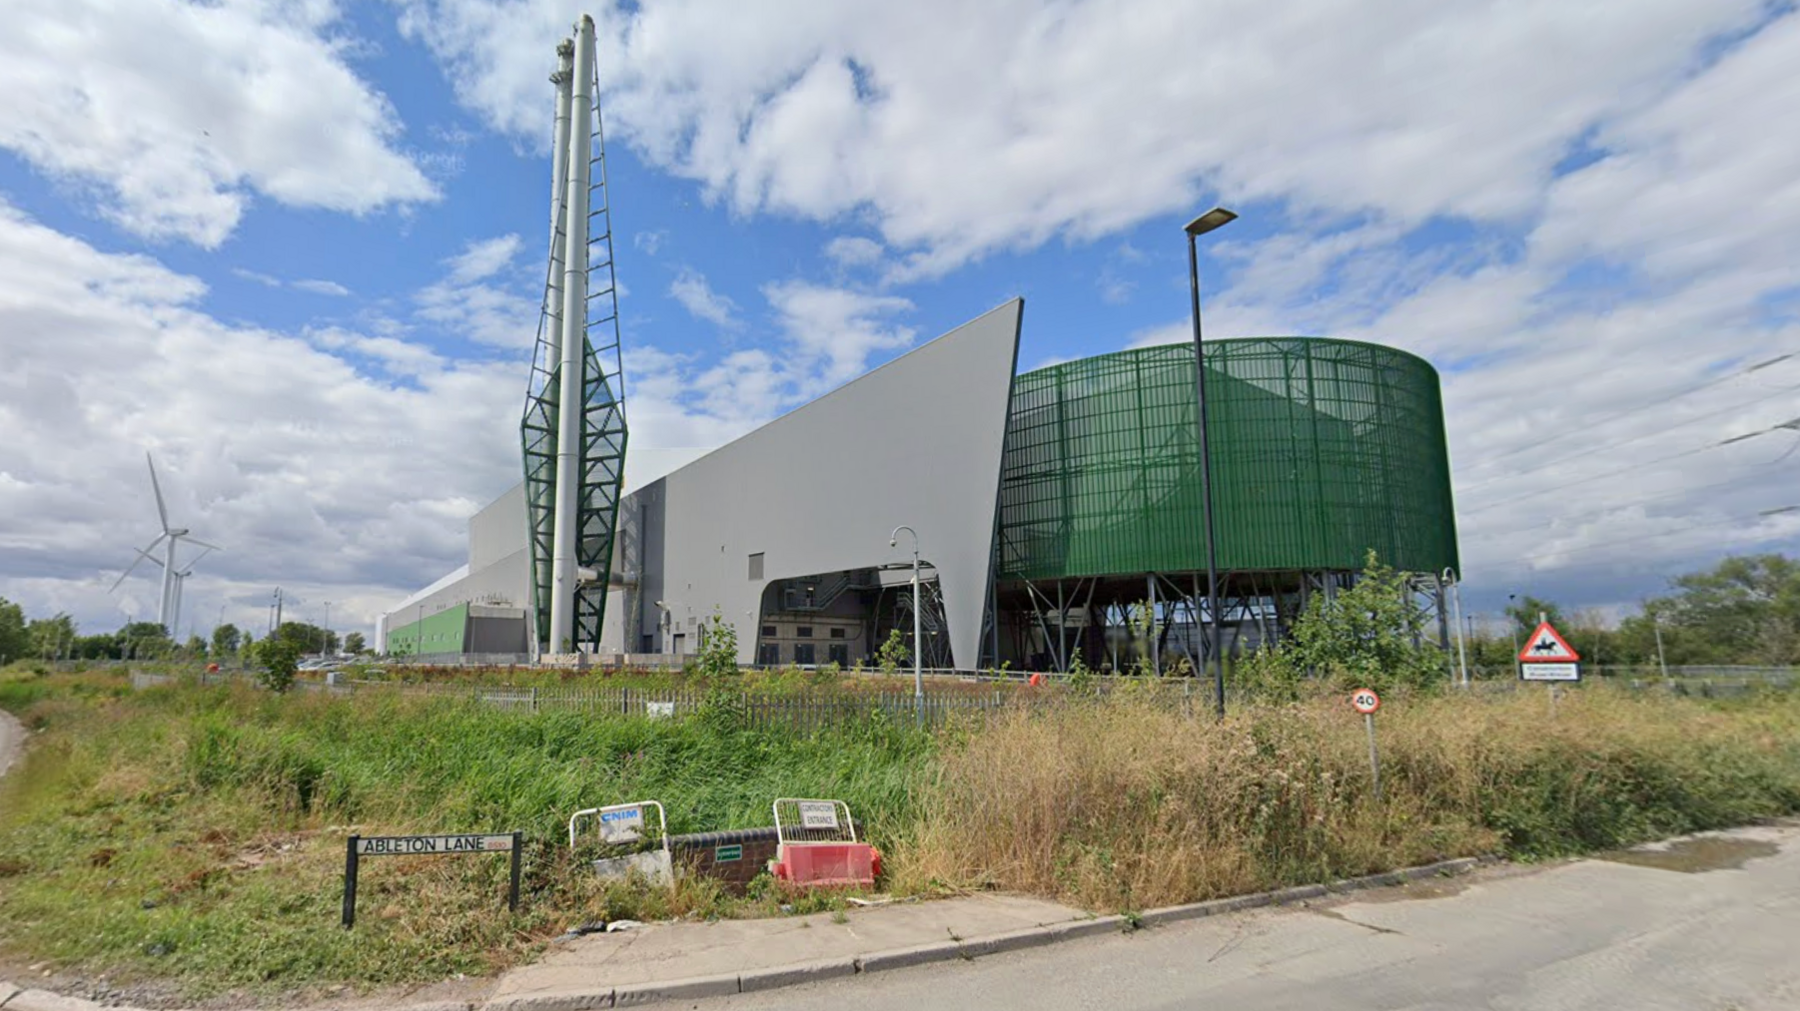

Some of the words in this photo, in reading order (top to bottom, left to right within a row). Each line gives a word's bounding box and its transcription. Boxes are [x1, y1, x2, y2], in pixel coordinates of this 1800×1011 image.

[1356, 695, 1375, 706] 40
[601, 809, 638, 823] CNIM
[807, 815, 834, 825] ENTRANCE
[363, 837, 436, 853] ABLETON
[445, 836, 485, 850] LANE
